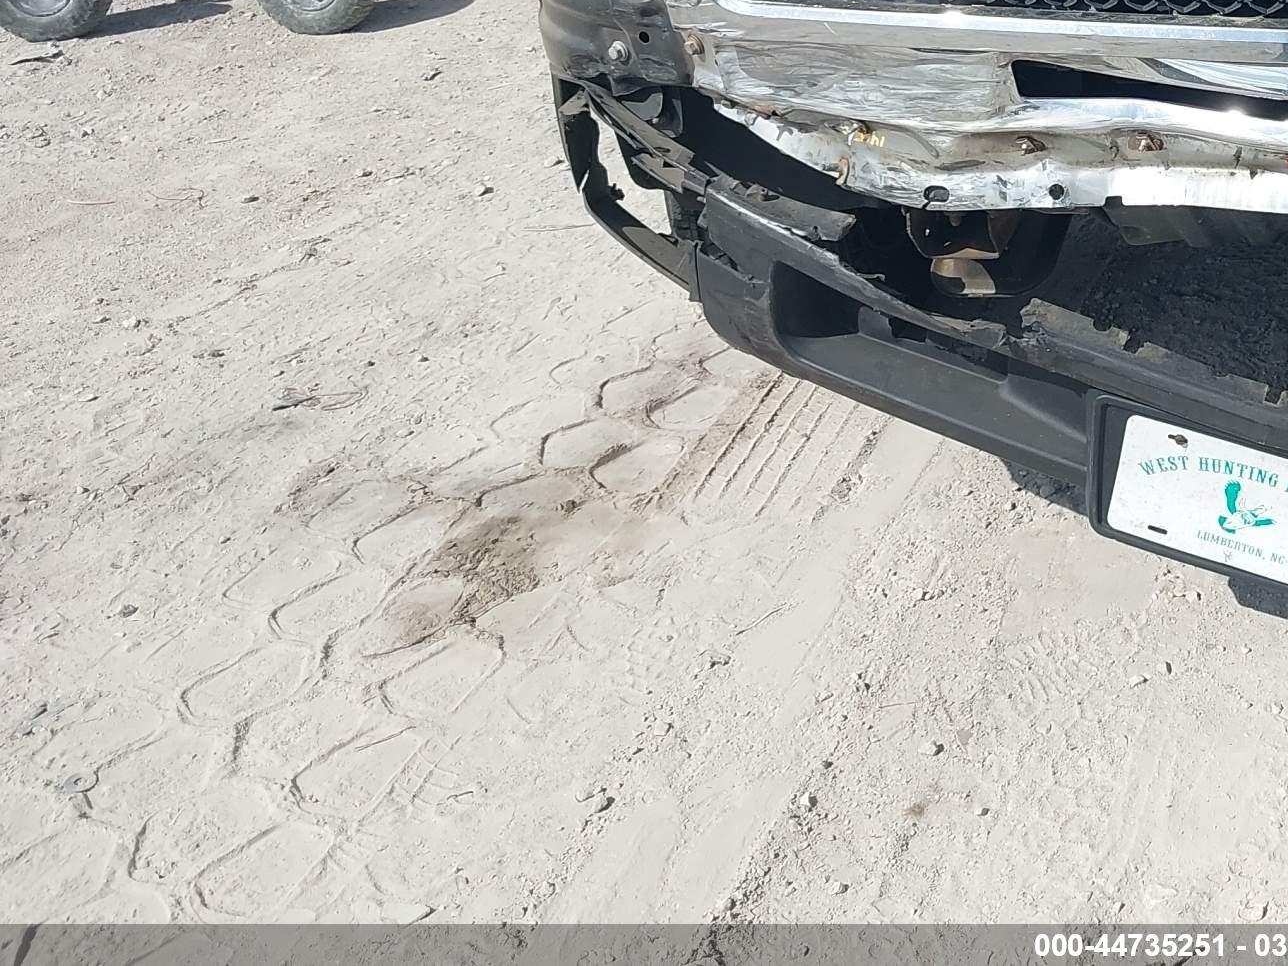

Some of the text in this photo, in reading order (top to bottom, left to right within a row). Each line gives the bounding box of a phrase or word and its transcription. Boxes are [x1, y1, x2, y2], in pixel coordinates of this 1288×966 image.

[1138, 455, 1189, 475] WEST
[1198, 456, 1279, 488] HUNTING
[1197, 529, 1266, 561] LUMBERTON,
